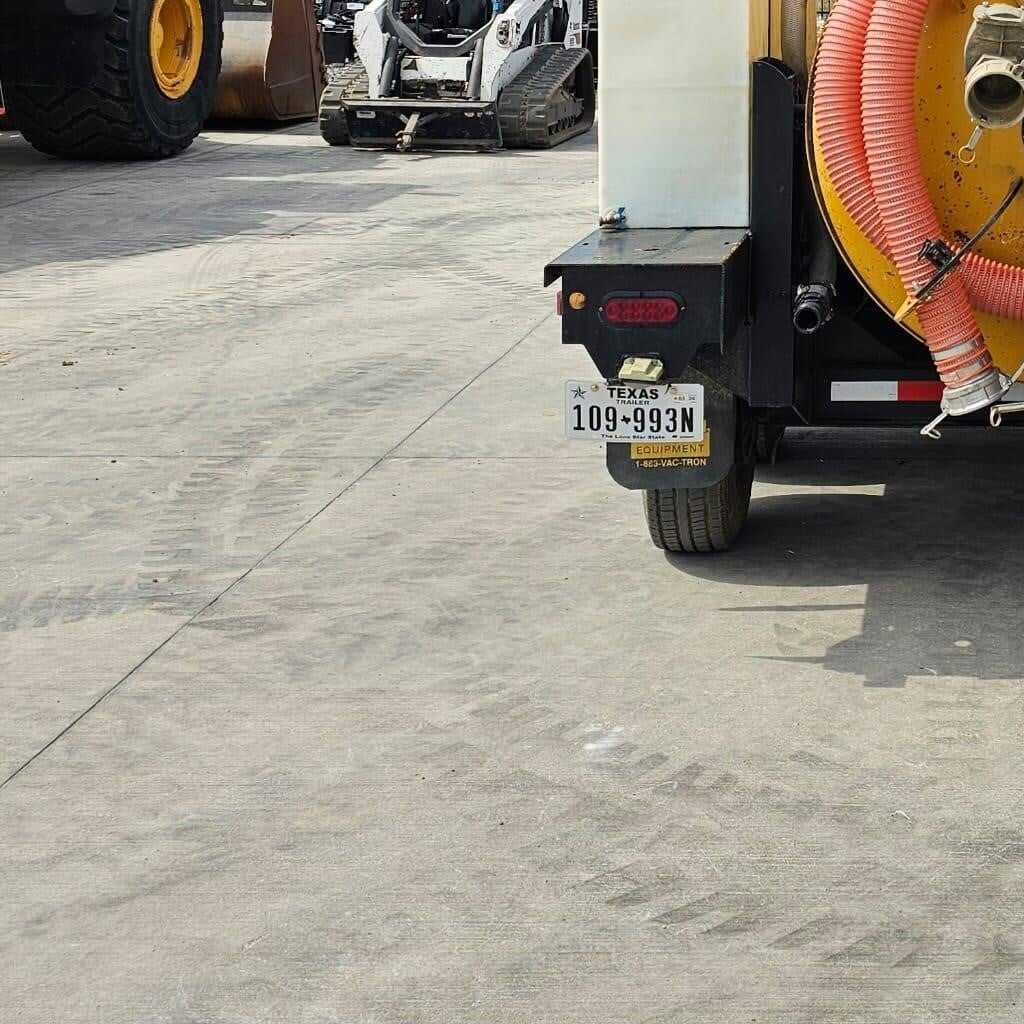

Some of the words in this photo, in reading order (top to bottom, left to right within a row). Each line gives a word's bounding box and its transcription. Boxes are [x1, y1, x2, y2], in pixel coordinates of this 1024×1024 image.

[607, 387, 659, 400] TEXAS
[573, 404, 617, 432] 109
[633, 407, 694, 433] 993N
[636, 443, 705, 455] EQUIPMENT
